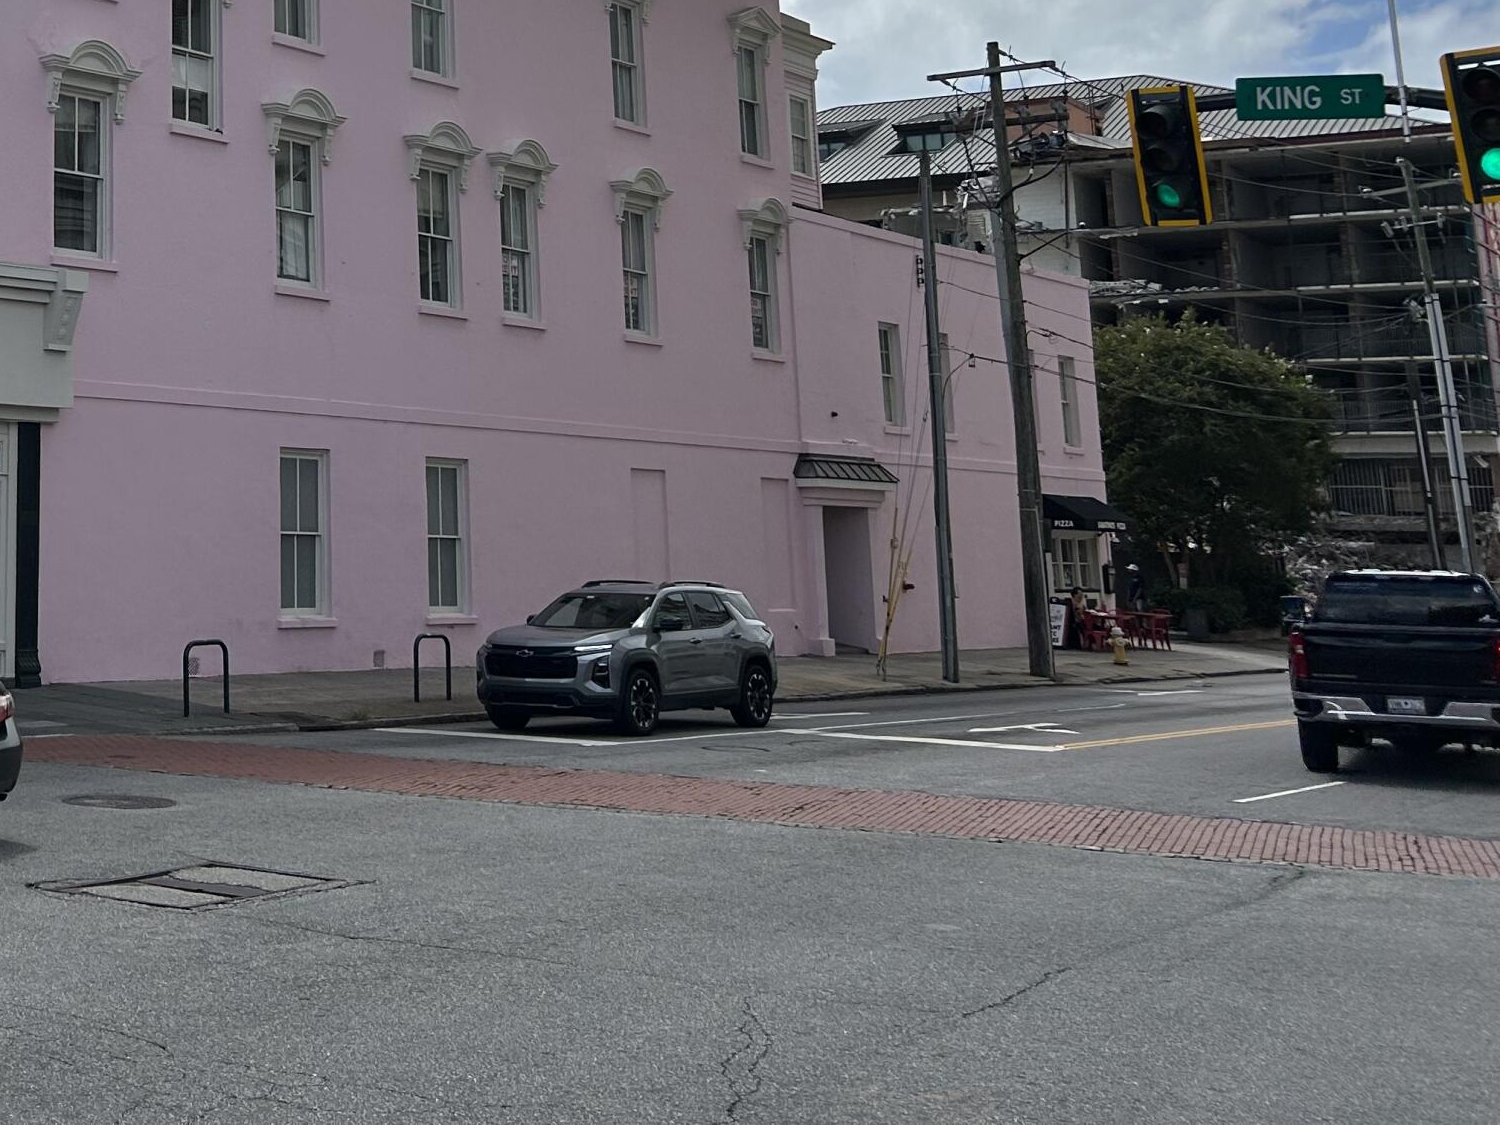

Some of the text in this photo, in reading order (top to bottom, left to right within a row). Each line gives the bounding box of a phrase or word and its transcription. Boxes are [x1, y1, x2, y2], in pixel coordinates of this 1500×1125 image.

[1256, 85, 1363, 111] KING ST
[1054, 519, 1075, 528] PIZZA
